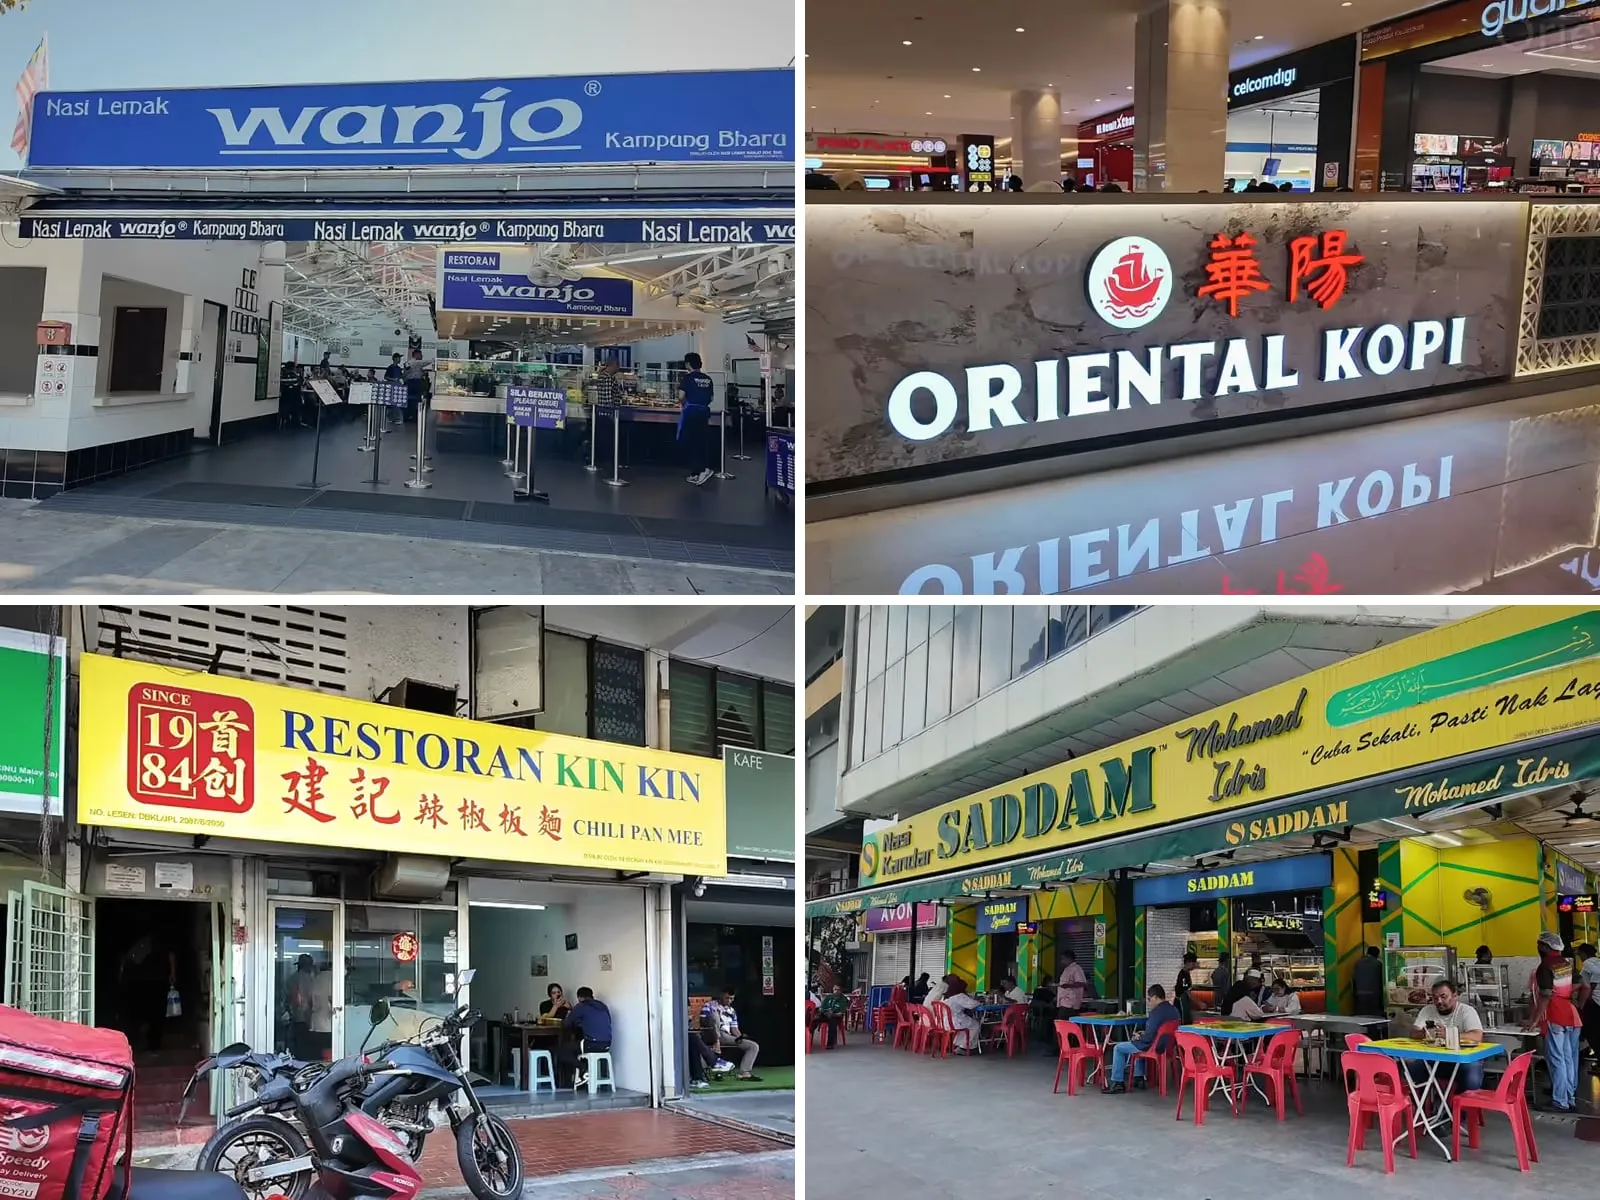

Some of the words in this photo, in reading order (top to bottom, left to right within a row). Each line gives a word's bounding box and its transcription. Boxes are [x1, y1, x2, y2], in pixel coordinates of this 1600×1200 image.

[1233, 67, 1297, 96] celcomdigi
[46, 98, 89, 117] Nasi
[98, 96, 169, 116] Lemak
[605, 131, 710, 151] Kampung
[718, 129, 787, 148] Bharu
[32, 220, 61, 239] Nasi
[65, 221, 112, 239] Lemak
[193, 221, 246, 240] Kampung
[249, 221, 284, 237] Bharu
[314, 221, 346, 240] Nasi
[352, 221, 404, 240] Lemak
[496, 221, 558, 241] Kampung
[563, 221, 604, 238] Bharu
[642, 221, 681, 242] Nasi
[687, 220, 753, 242] Lemak
[448, 255, 496, 266] RESTORAN
[447, 275, 468, 283] Nasi
[470, 275, 503, 283] Lemak
[1198, 230, 1366, 317] 華陽
[887, 333, 1299, 441] ORIENTAL
[1323, 317, 1466, 382] KOPI
[510, 388, 526, 397] SILA
[528, 390, 563, 401] BERATUR
[142, 688, 191, 706] SINCE
[1430, 707, 1489, 734] Pasti
[1495, 686, 1549, 716] Nak
[144, 713, 193, 749] 19
[1175, 687, 1308, 762] Mohamed
[280, 709, 544, 784] RESTORAN
[555, 752, 625, 794] KIN
[636, 765, 701, 804] KIN
[734, 753, 763, 771] KAFE
[142, 753, 192, 791] 84
[1208, 758, 1266, 802] Idris
[937, 746, 1156, 859] SADDAM
[1249, 801, 1348, 840] SADDAM
[1395, 765, 1504, 809] Mohamed
[1512, 757, 1571, 788] Idris
[89, 808, 104, 816] NO.
[573, 819, 624, 839] CHILI
[631, 825, 663, 843] PAN
[667, 829, 703, 846] MEE
[883, 825, 912, 852] Nasi
[971, 868, 1012, 891] SADDAM
[1187, 871, 1254, 893] SADDAM
[985, 902, 1016, 915] SADDAM
[13, 1169, 47, 1180] Delivery
